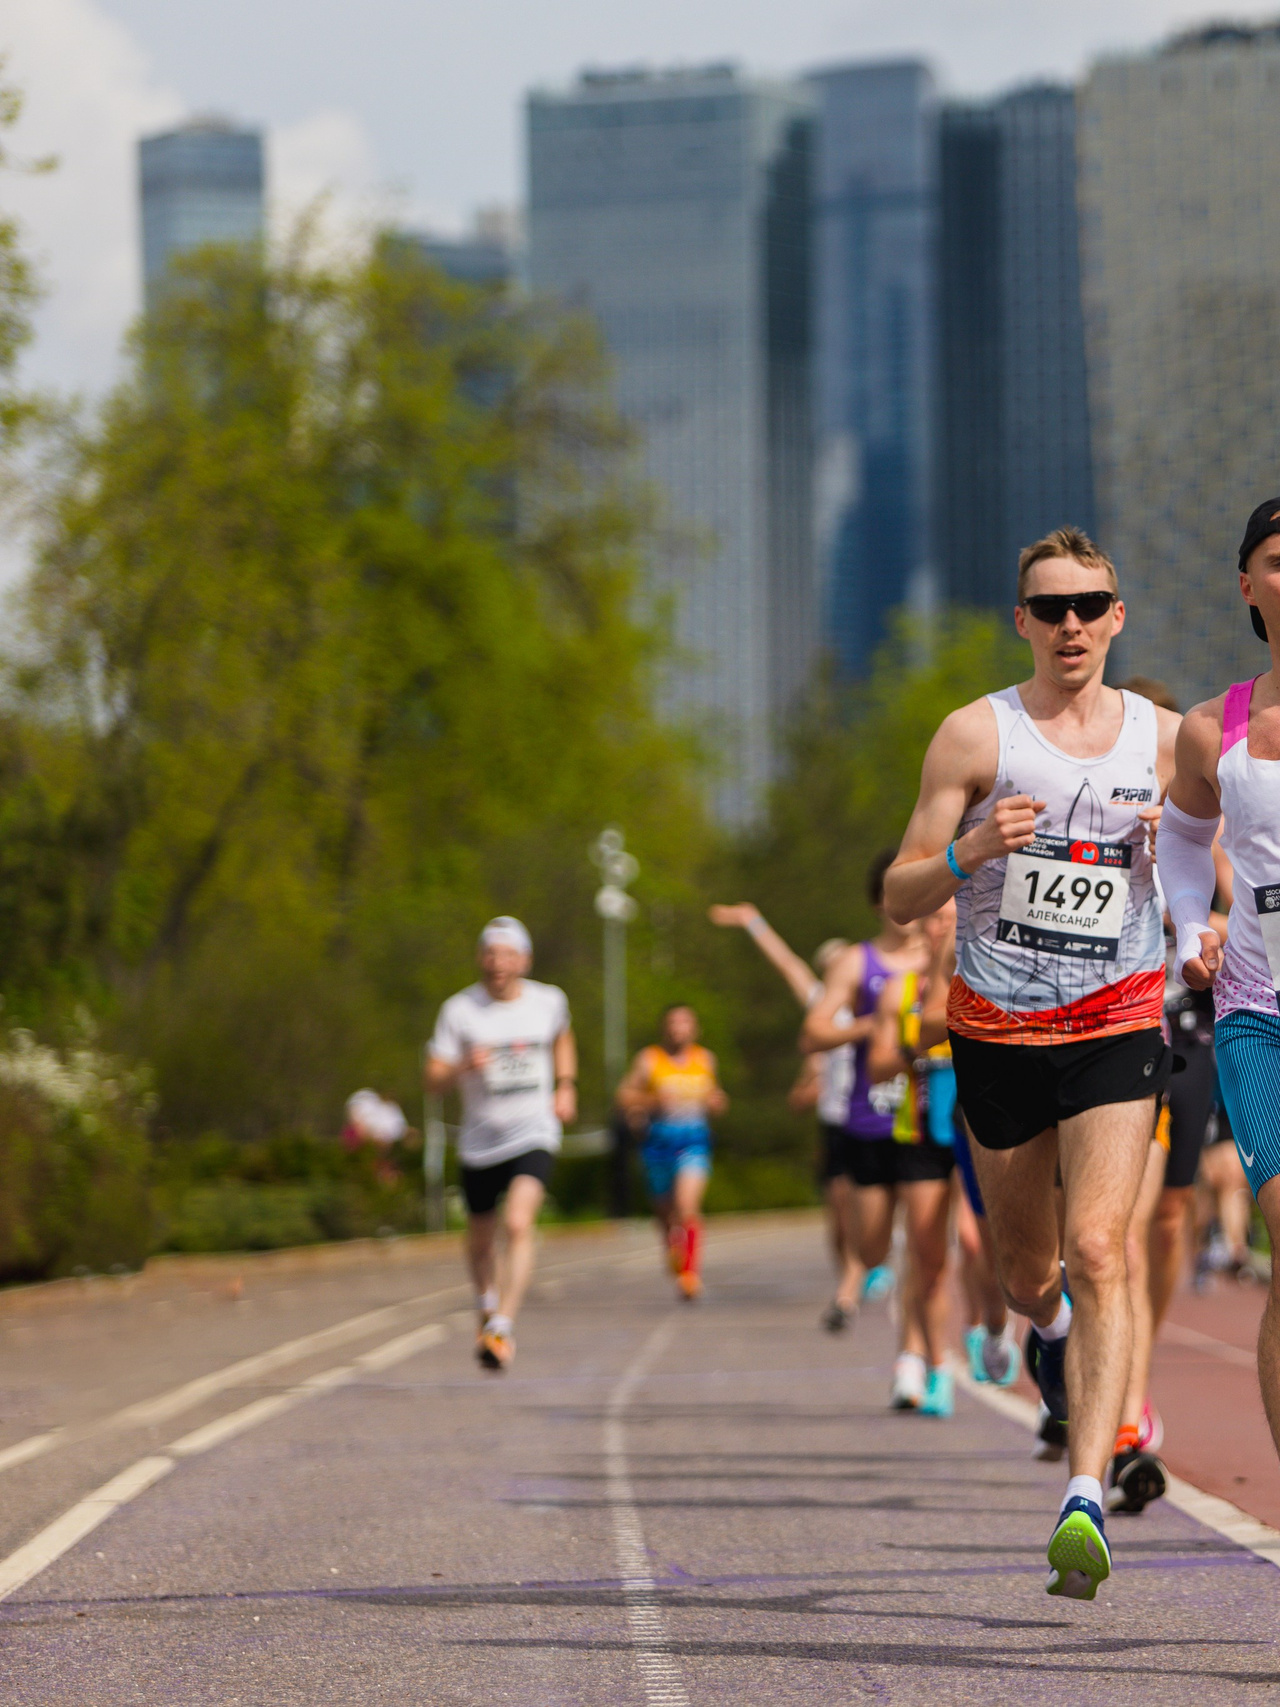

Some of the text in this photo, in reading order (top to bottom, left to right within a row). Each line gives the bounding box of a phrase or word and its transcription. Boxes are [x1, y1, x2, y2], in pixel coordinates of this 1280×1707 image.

[1034, 837, 1068, 847] СКОВСКИЙ
[1022, 846, 1055, 857] МАРАФОН
[1024, 870, 1114, 914] 1499
[1027, 909, 1099, 928] АЛЕКСАНДР
